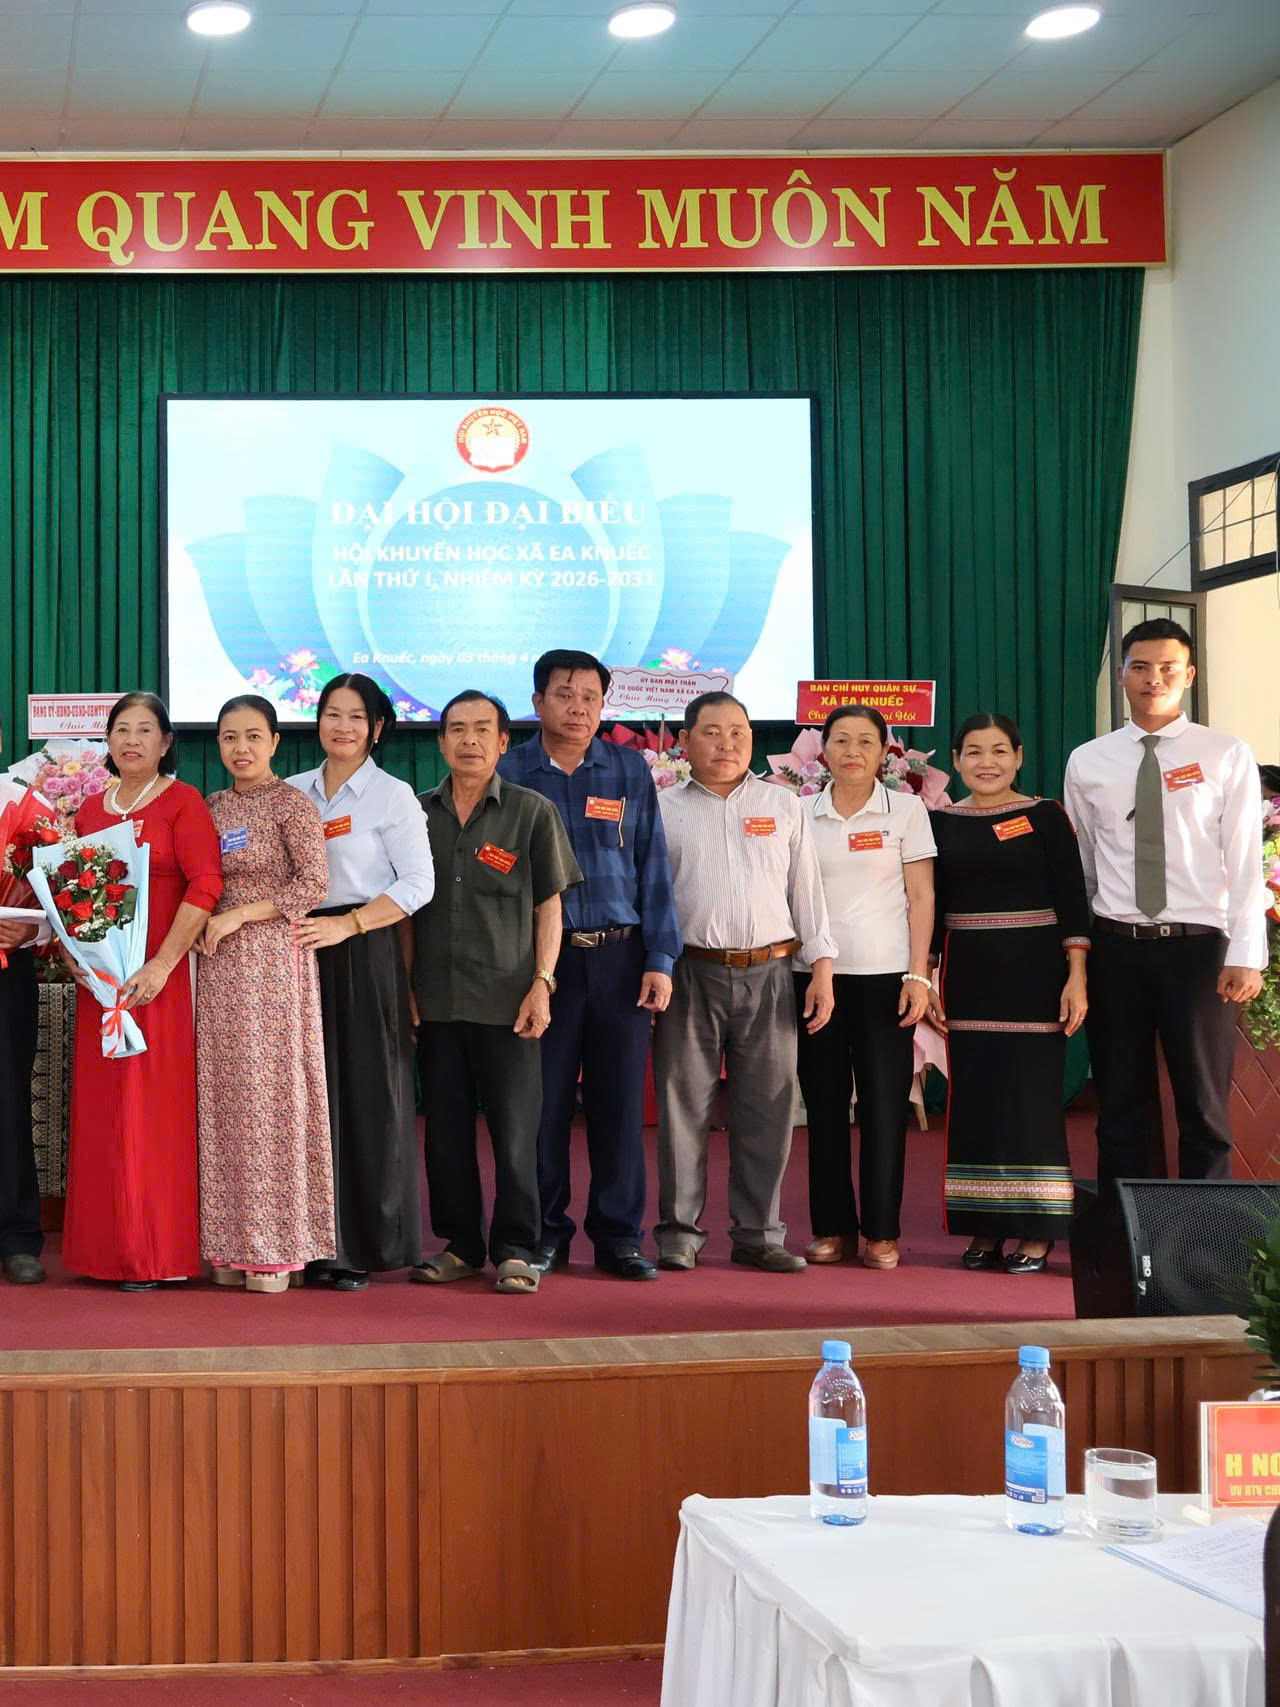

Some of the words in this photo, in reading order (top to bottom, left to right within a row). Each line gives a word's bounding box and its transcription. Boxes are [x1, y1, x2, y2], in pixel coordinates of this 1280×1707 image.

[76, 189, 374, 266] QUANG
[398, 189, 612, 250] VINH
[637, 169, 892, 249] MUÔN
[916, 167, 1109, 246] NĂM
[549, 544, 577, 561] EA
[810, 684, 830, 692] BAN
[851, 684, 870, 692] HUY
[821, 694, 838, 706] XÃ
[841, 696, 857, 706] EA
[1225, 1453, 1243, 1477] H
